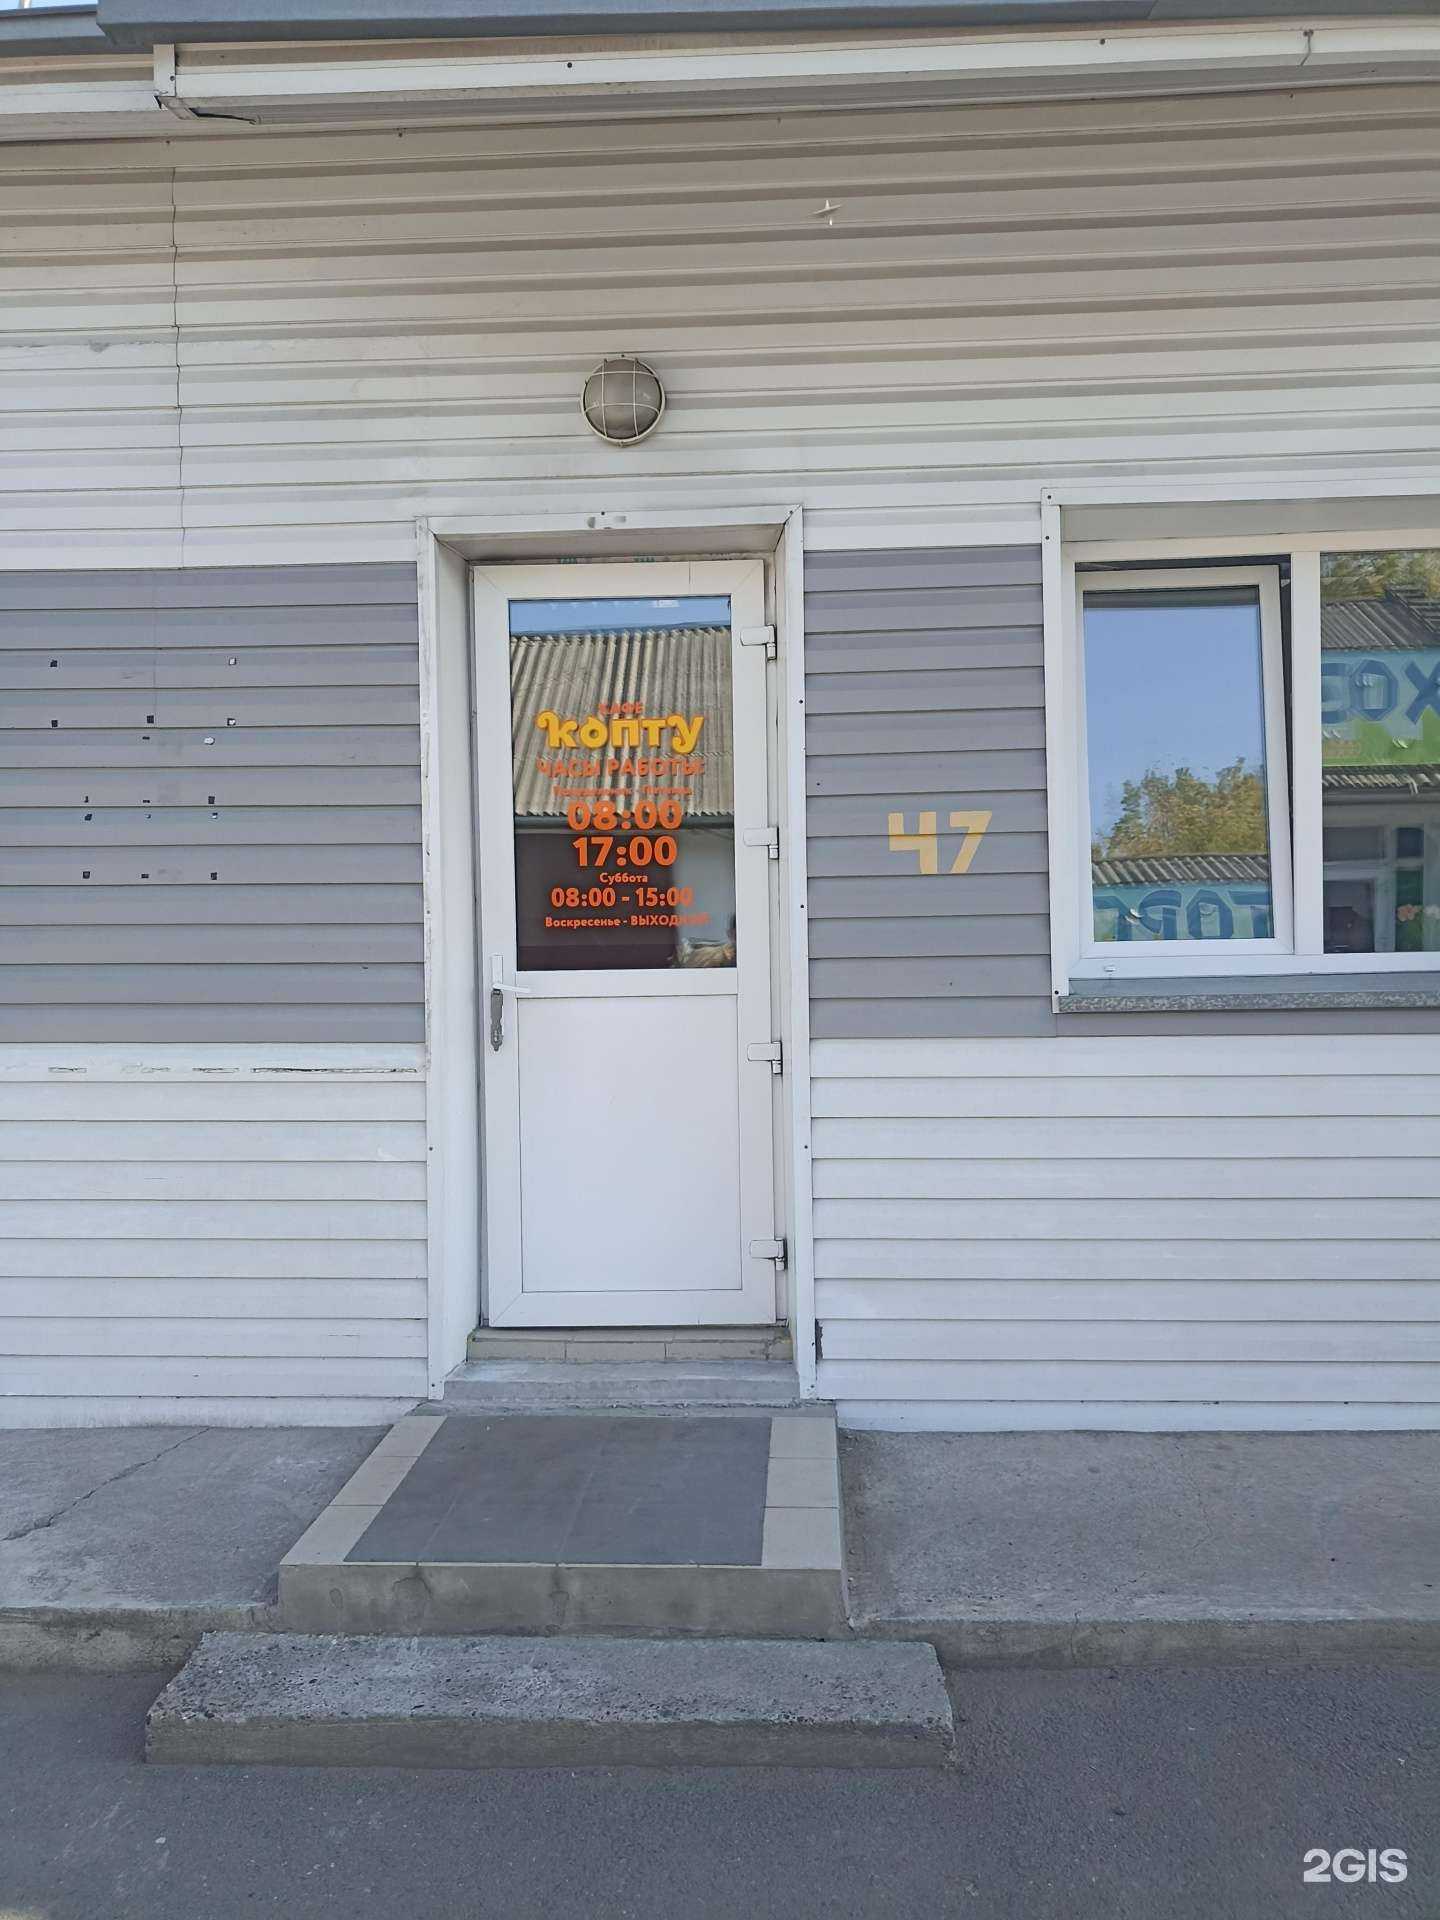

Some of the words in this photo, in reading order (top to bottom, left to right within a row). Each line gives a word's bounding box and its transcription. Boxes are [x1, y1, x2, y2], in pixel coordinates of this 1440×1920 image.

[537, 757, 600, 778] ЧАСЫ
[607, 756, 705, 777] РАБОТЫ
[567, 799, 683, 831] 08:00
[572, 835, 678, 867] 17:00
[888, 811, 992, 875] 47
[600, 872, 649, 885] Суббота
[551, 887, 616, 907] 08:00
[635, 886, 694, 907] 15:00
[545, 916, 621, 929] Воскресенье
